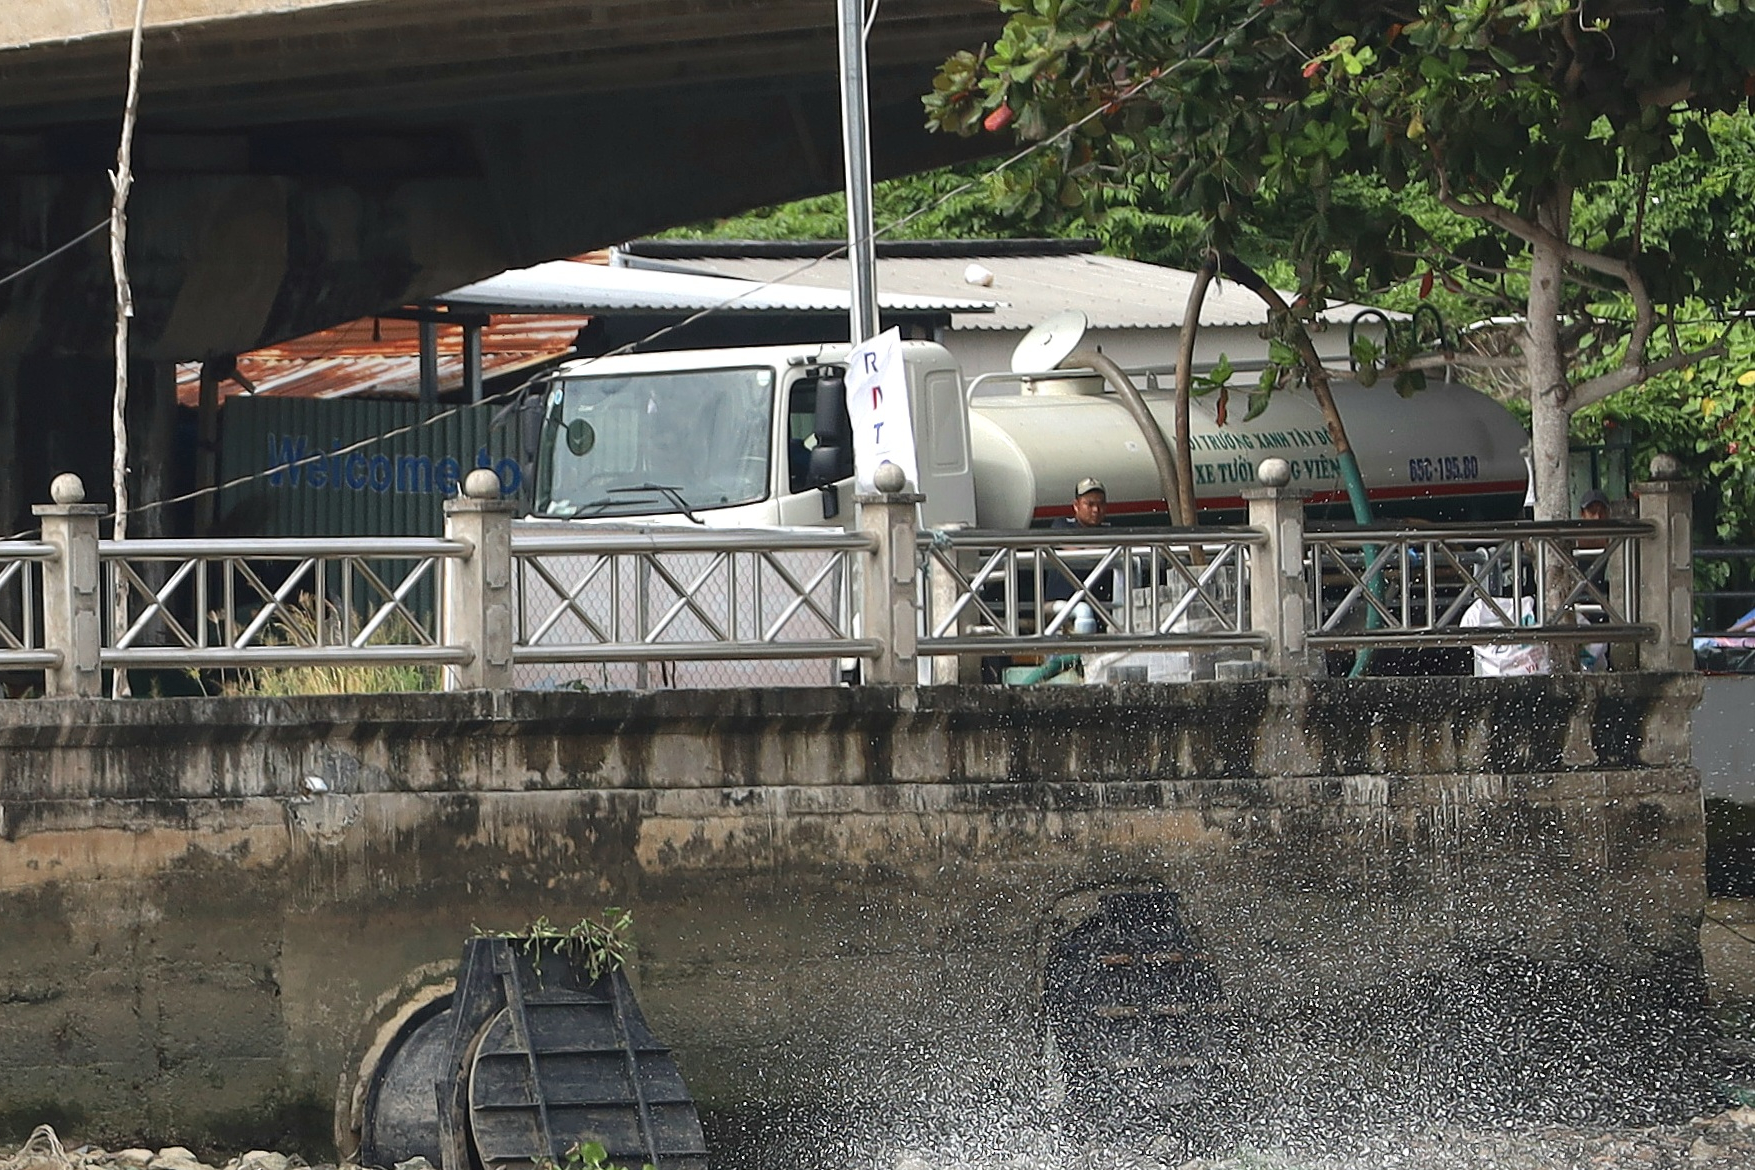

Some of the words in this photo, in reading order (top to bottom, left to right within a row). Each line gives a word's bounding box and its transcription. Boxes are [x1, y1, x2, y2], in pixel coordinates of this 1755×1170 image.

[863, 351, 894, 465] RAT
[1252, 431, 1291, 449] XANH
[267, 433, 460, 494] Welcome
[1194, 463, 1216, 485] XE
